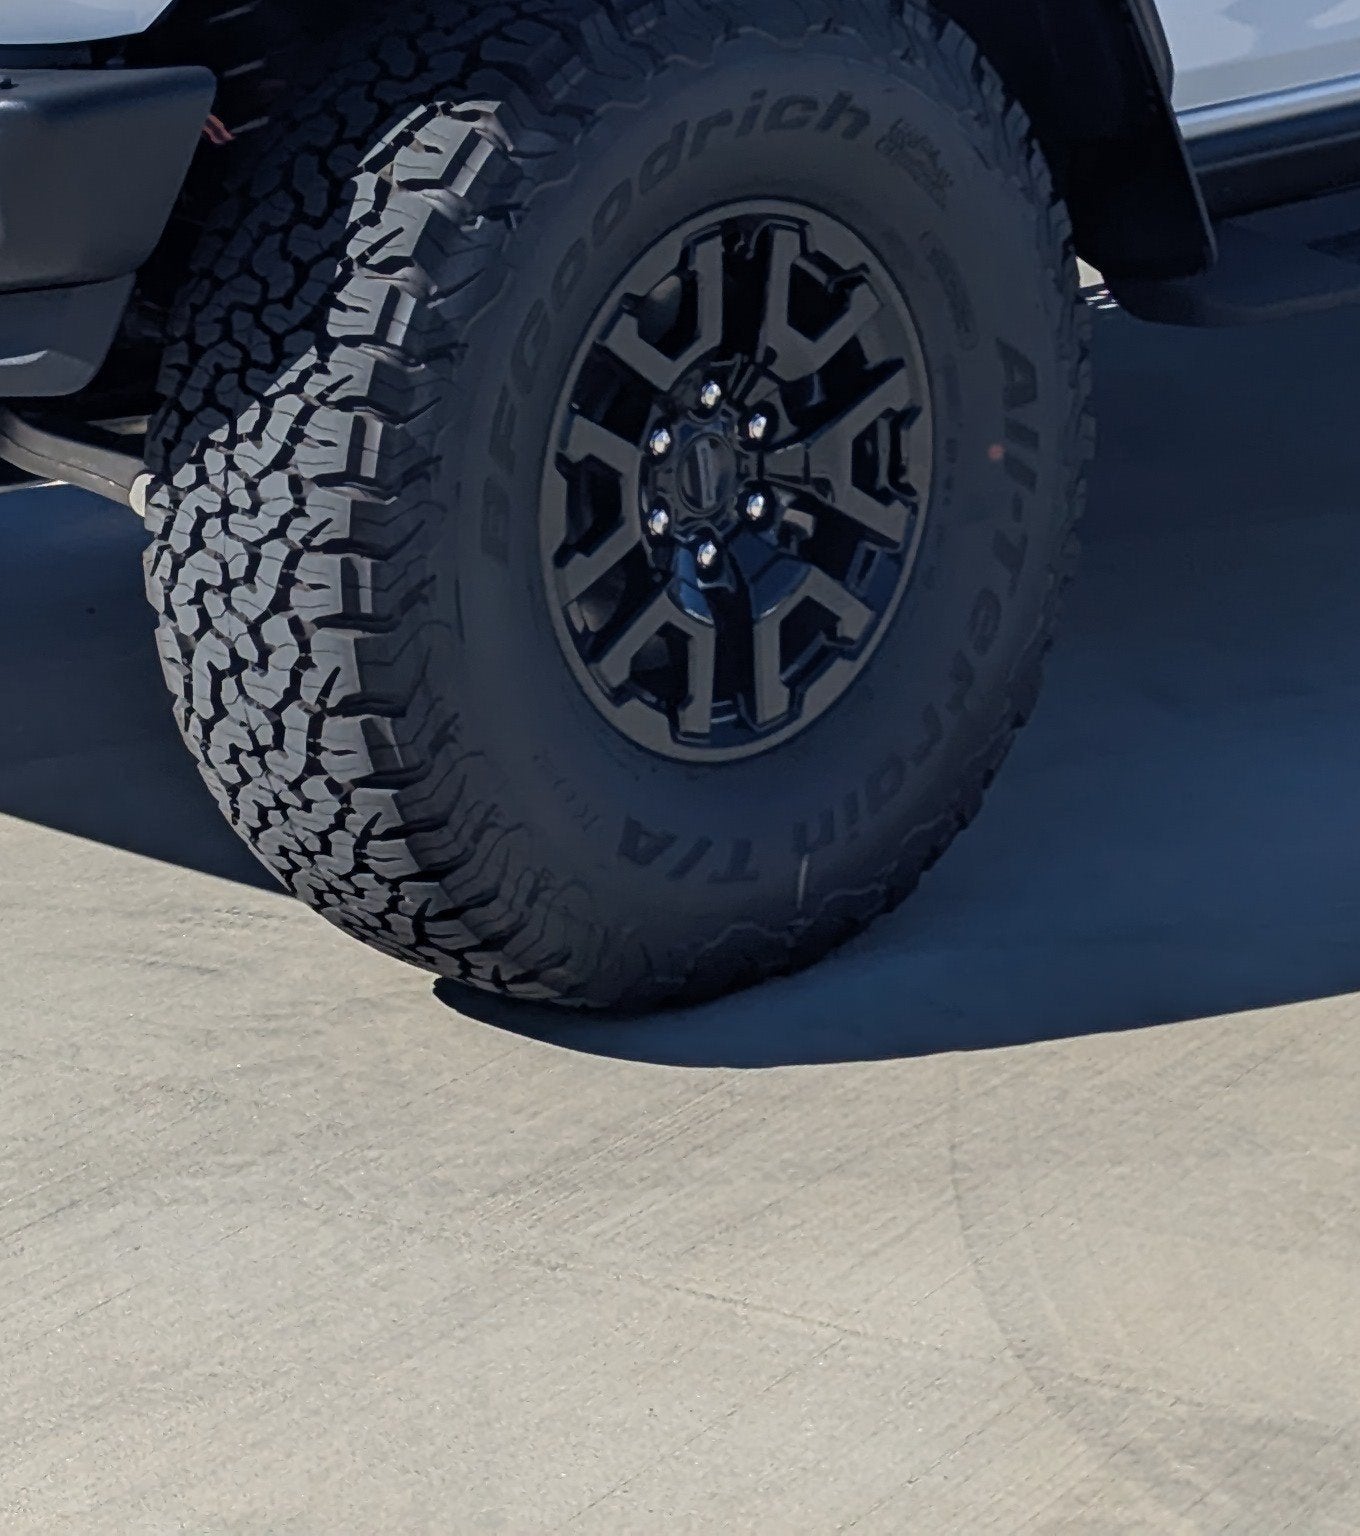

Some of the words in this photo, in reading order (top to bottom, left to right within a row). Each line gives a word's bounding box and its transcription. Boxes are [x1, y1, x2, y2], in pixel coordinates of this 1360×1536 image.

[479, 88, 873, 565] BFGoodrich
[792, 336, 1040, 859] All-Terrain
[617, 814, 761, 885] T/A
